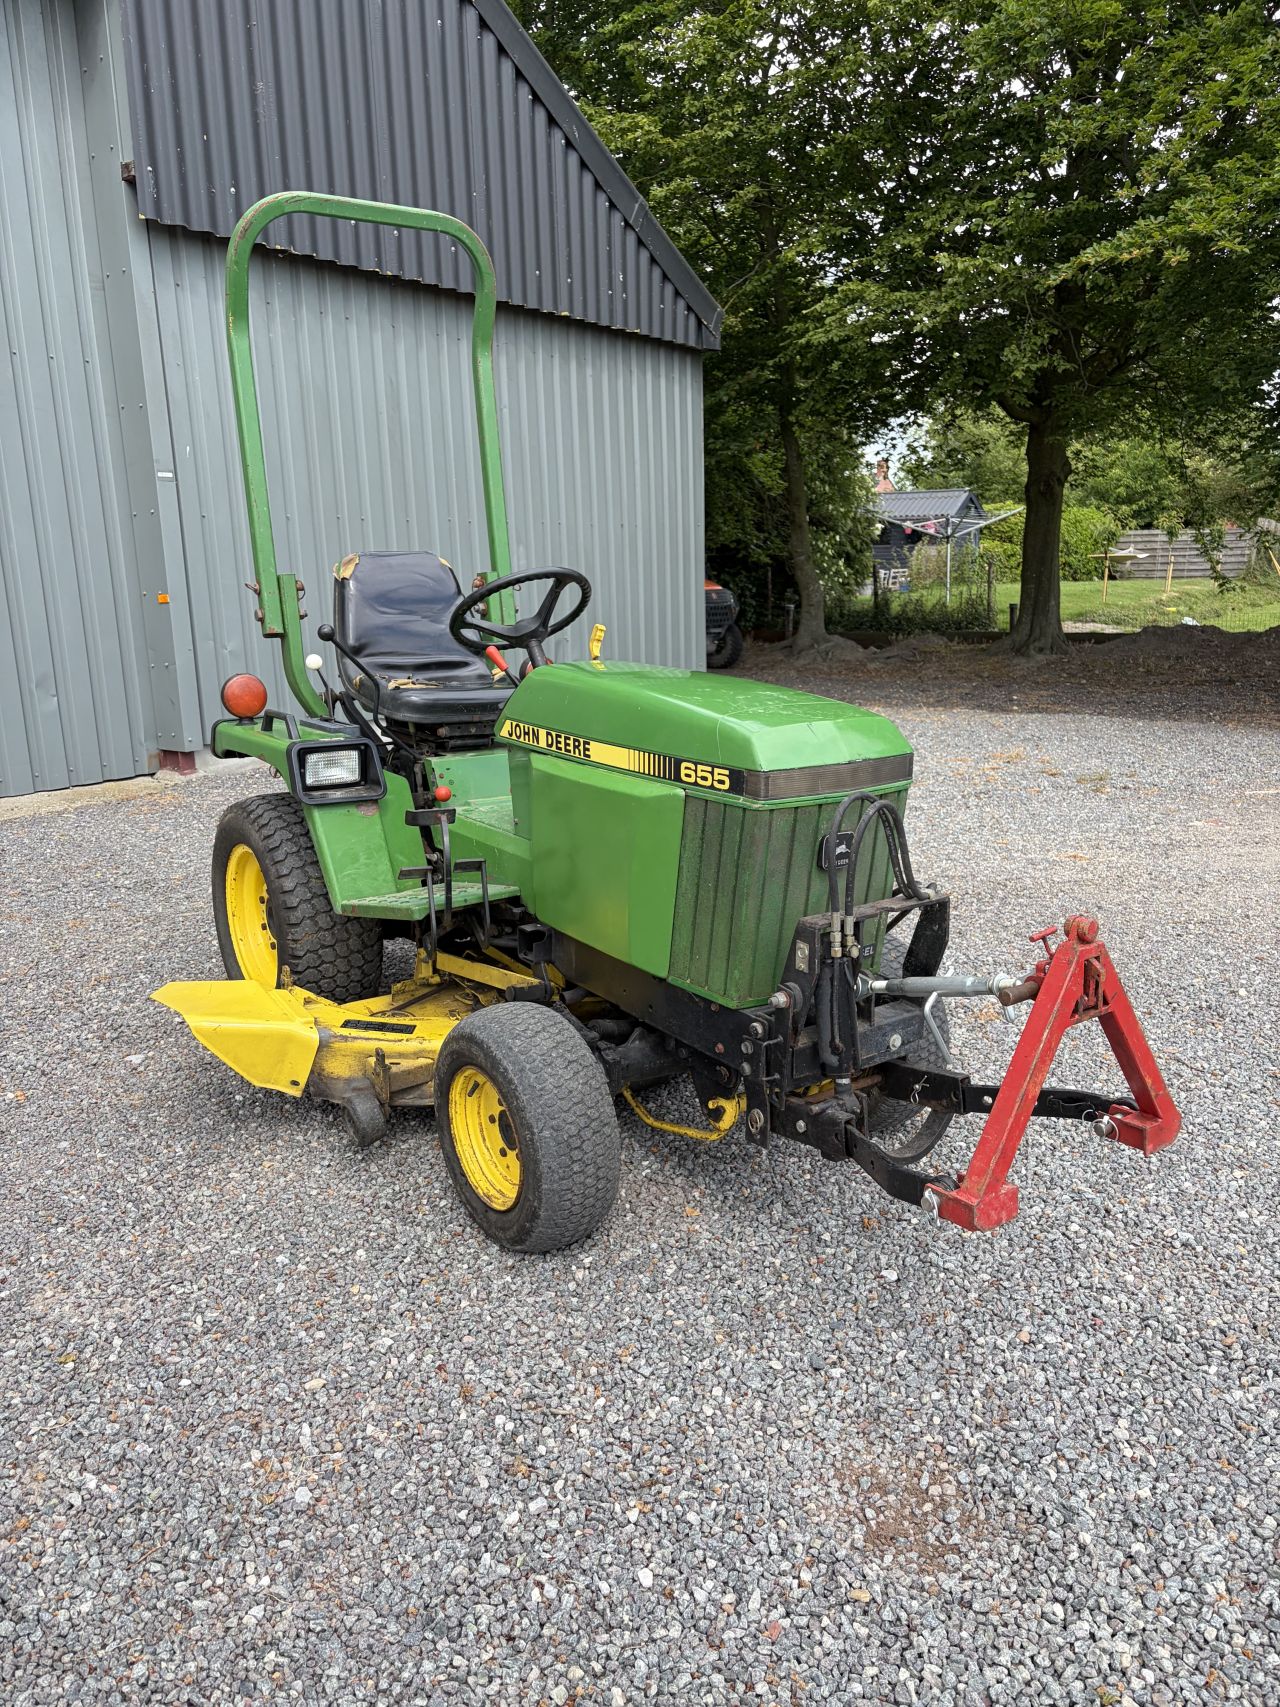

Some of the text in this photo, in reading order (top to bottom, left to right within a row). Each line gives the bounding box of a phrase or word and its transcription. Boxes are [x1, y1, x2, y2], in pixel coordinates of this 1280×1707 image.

[507, 721, 591, 759] JOHN DEERE
[680, 761, 730, 790] 655
